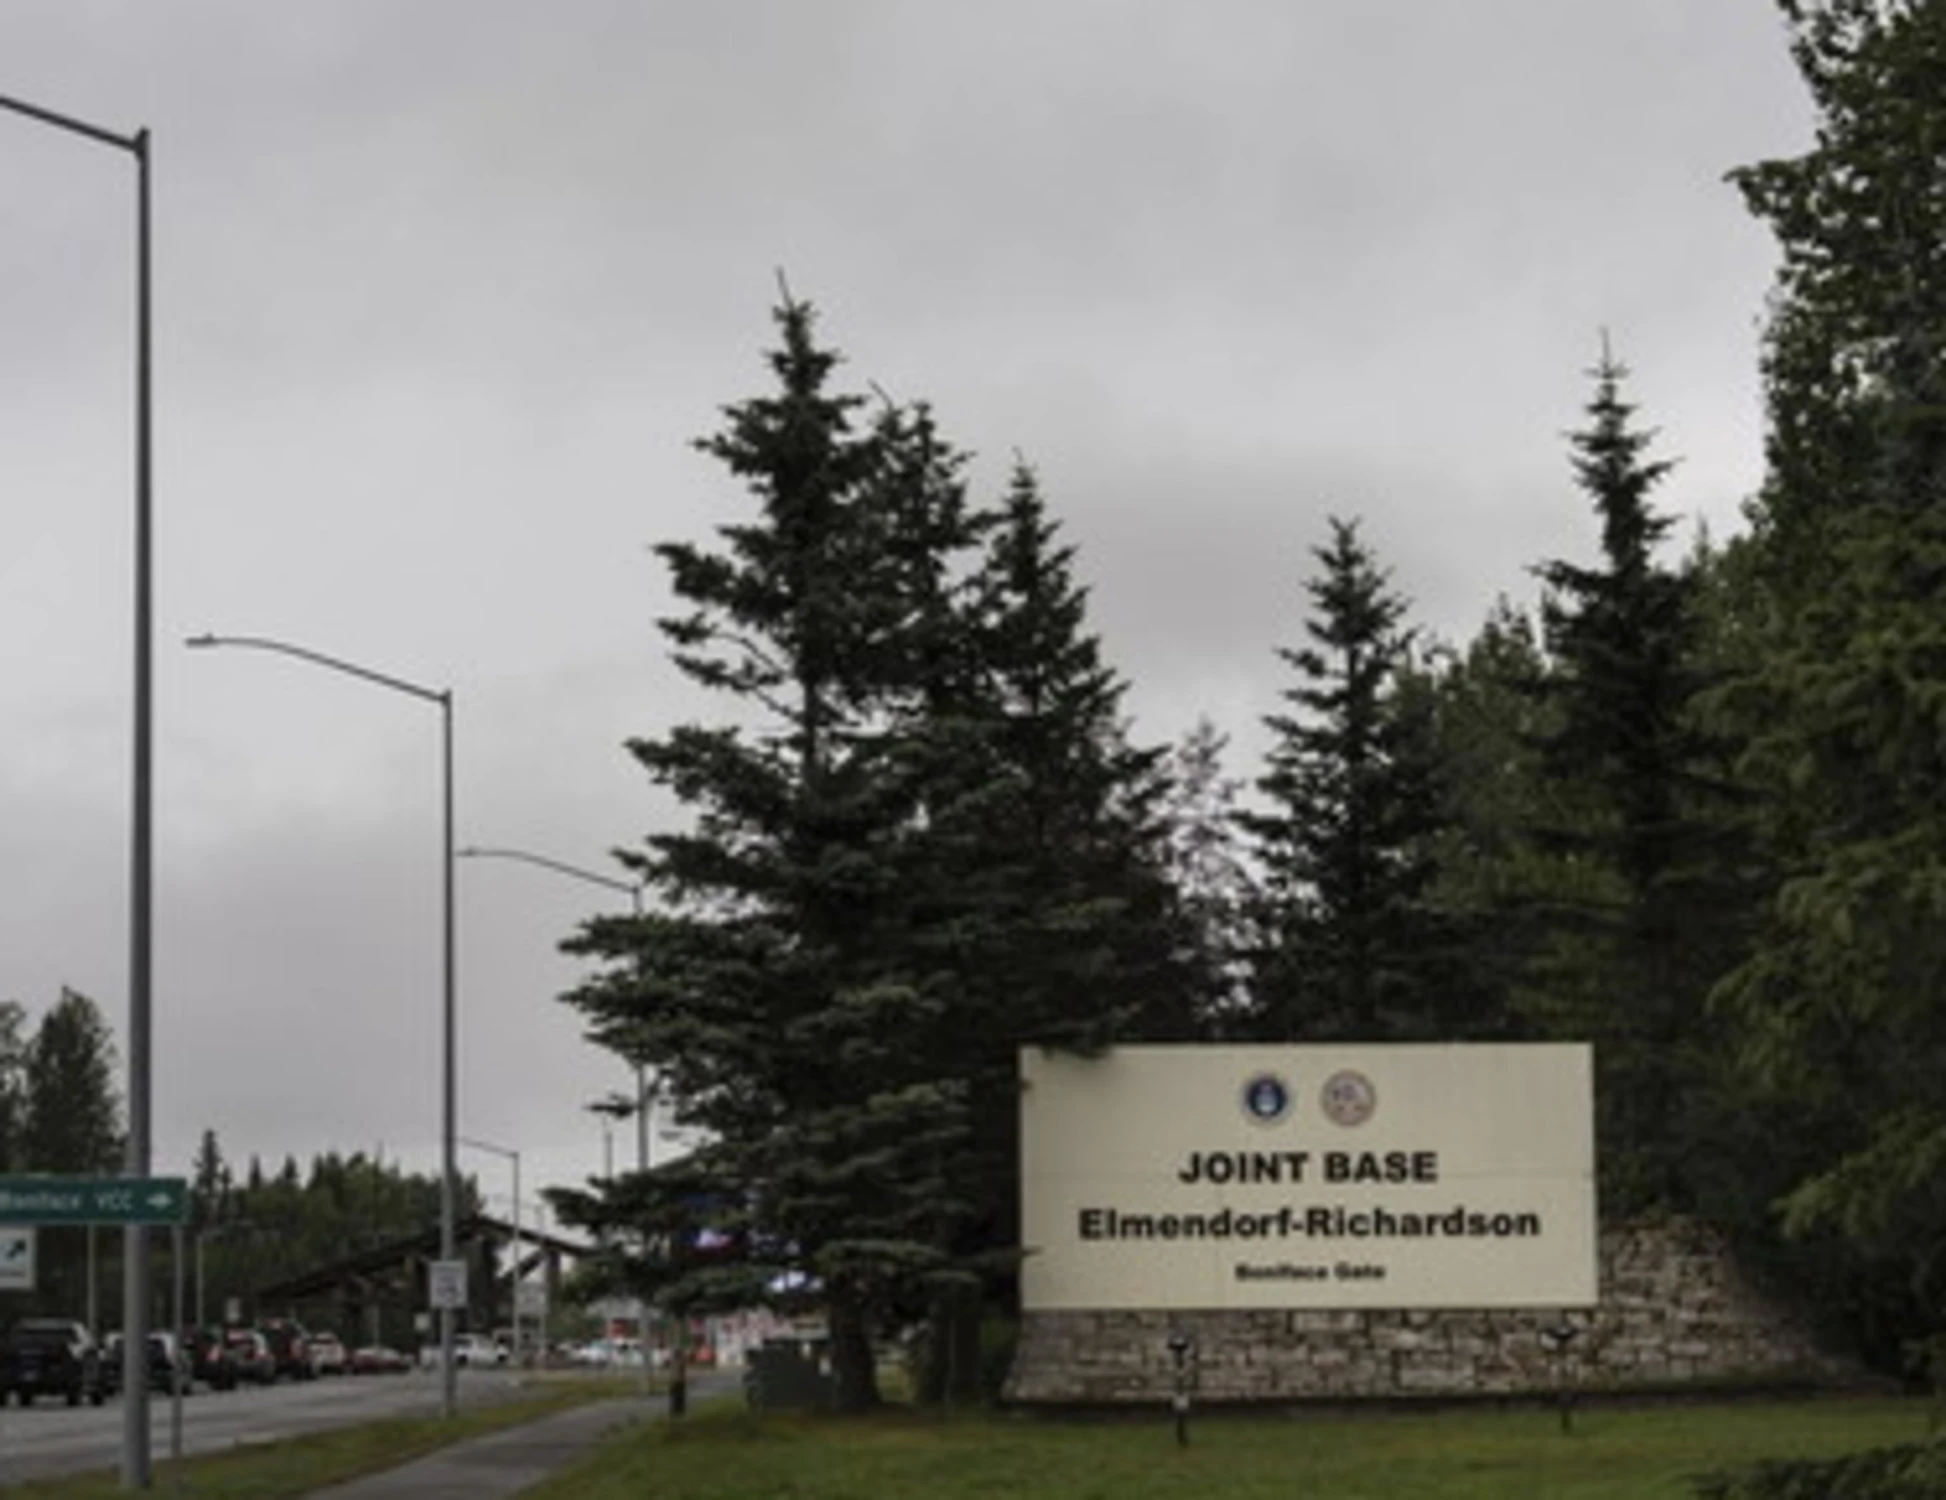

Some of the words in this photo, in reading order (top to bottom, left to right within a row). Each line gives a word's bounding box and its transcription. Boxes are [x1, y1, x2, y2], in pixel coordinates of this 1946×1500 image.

[1177, 1151, 1310, 1185] JOINT
[1323, 1151, 1438, 1184] BASE
[1078, 1207, 1540, 1241] Elmendorf-Richardson
[1234, 1261, 1329, 1283] Boniface
[1333, 1261, 1386, 1282] Gate
